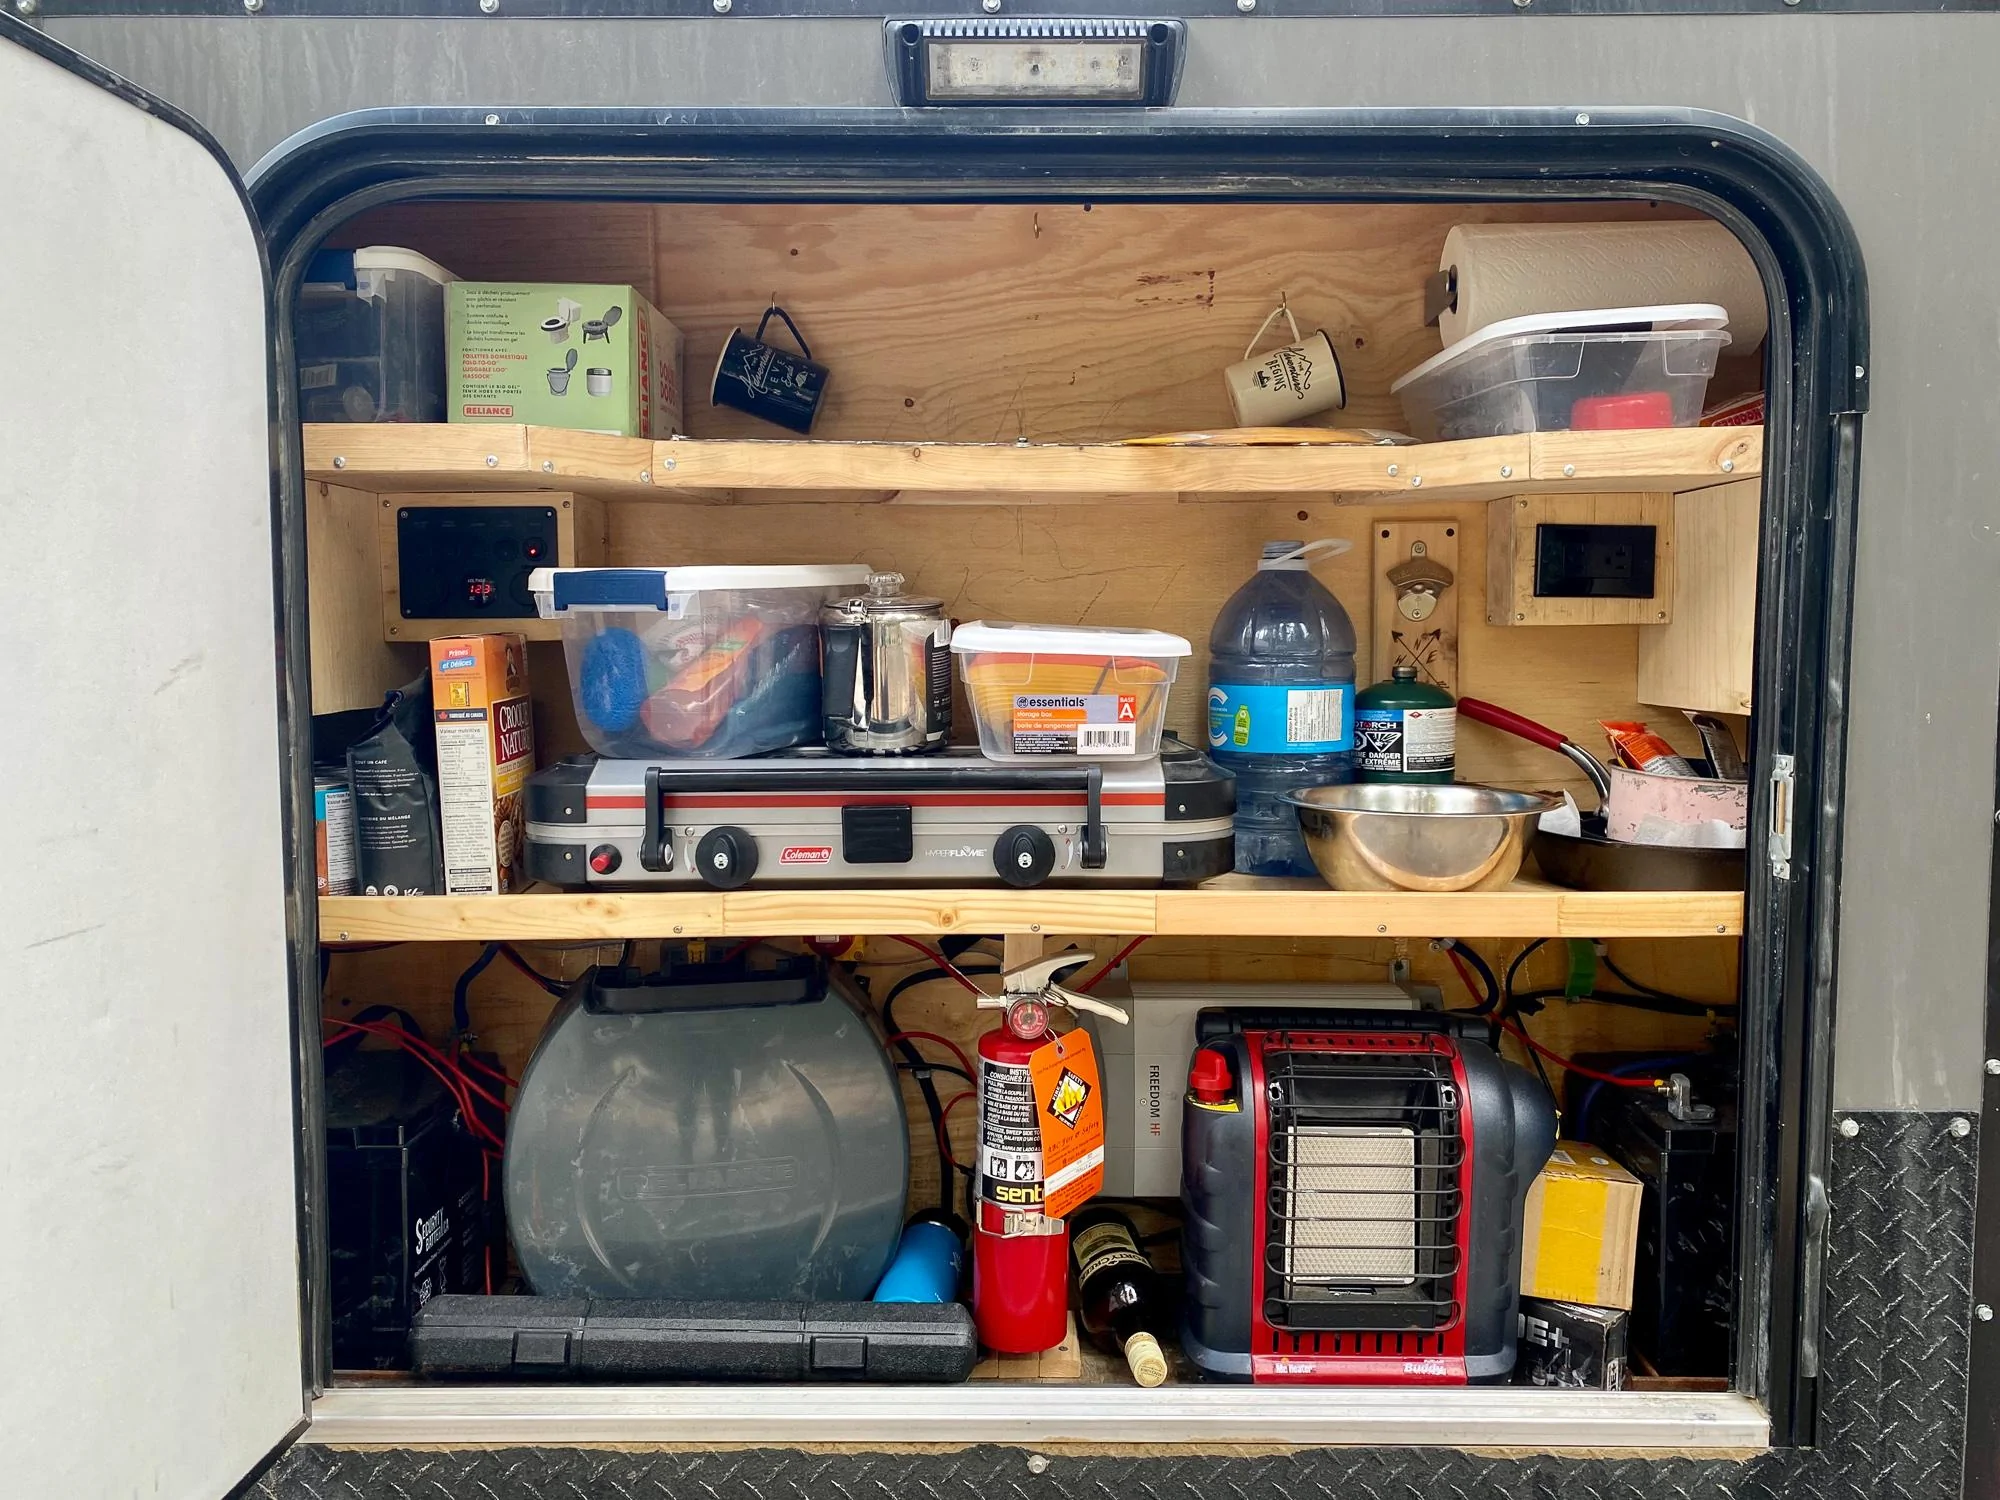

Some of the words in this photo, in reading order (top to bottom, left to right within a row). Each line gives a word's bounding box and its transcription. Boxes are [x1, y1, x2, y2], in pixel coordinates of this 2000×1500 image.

[640, 316, 649, 438] ELIANCE
[1265, 359, 1287, 392] BEGINS
[466, 407, 511, 415] RELIANCE
[1030, 696, 1085, 707] essentials
[1119, 702, 1135, 719] A
[1043, 722, 1077, 730] rangement
[1369, 752, 1401, 760] DANGER
[784, 848, 821, 860] Coleman
[925, 847, 985, 857] HYPERFLAME
[990, 1071, 1022, 1082] CONSIGNES
[1067, 1071, 1083, 1085] SAFETY
[1149, 1065, 1160, 1118] FREEDOM
[1082, 1121, 1099, 1136] Safety
[1150, 1123, 1160, 1136] HF
[996, 1184, 1043, 1203] sent
[1403, 1362, 1447, 1376] Buddy
